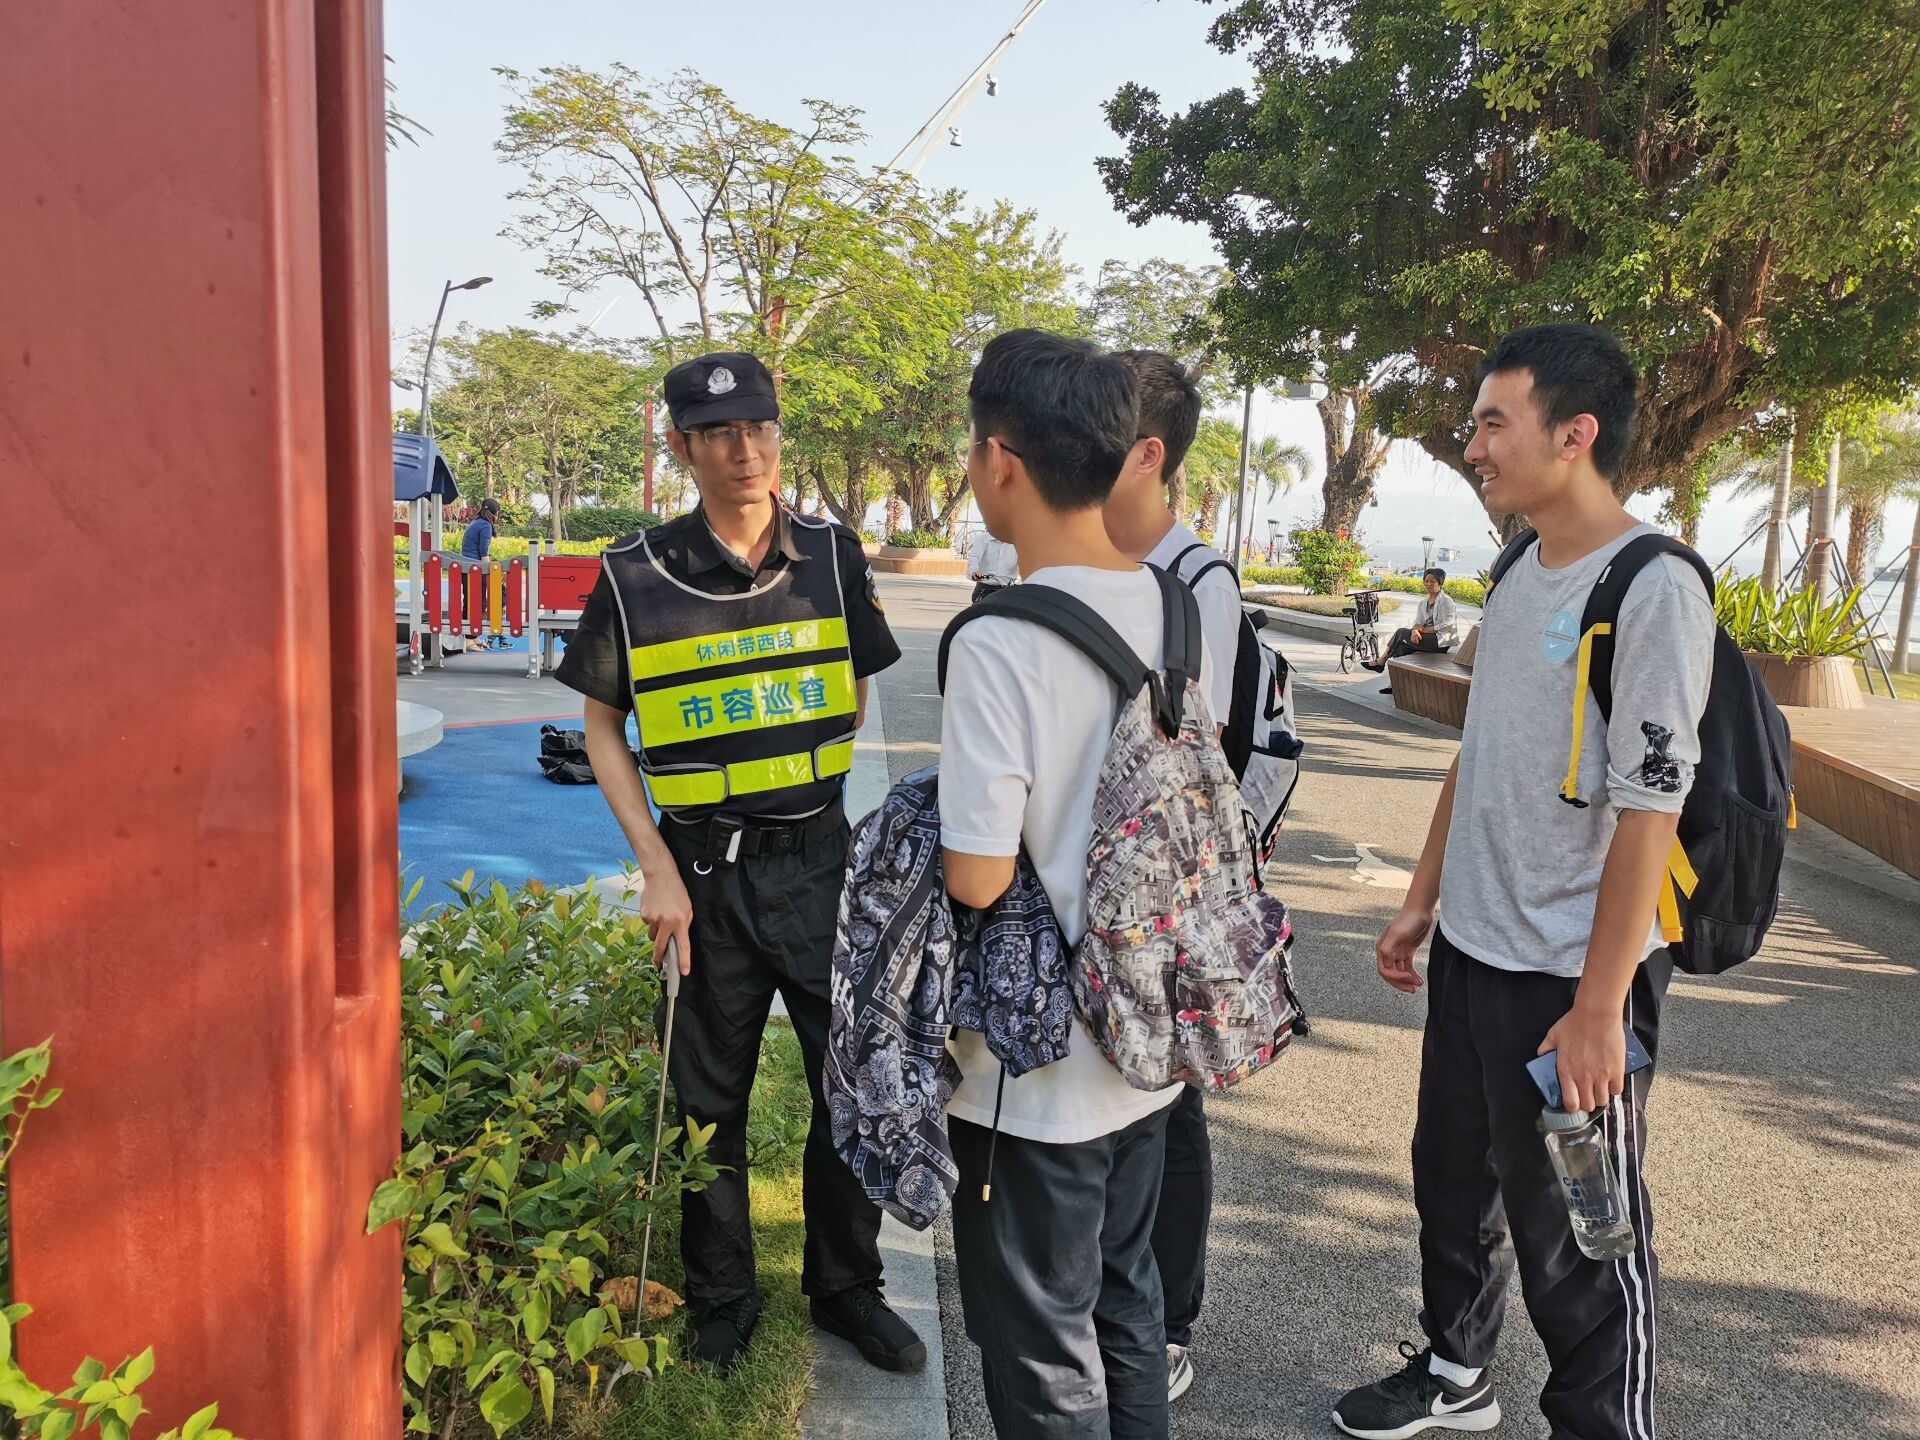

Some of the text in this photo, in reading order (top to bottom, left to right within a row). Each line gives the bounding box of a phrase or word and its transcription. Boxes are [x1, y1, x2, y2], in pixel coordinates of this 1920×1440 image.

[696, 630, 795, 663] 休闲带西段
[679, 676, 828, 729] 市容巡查
